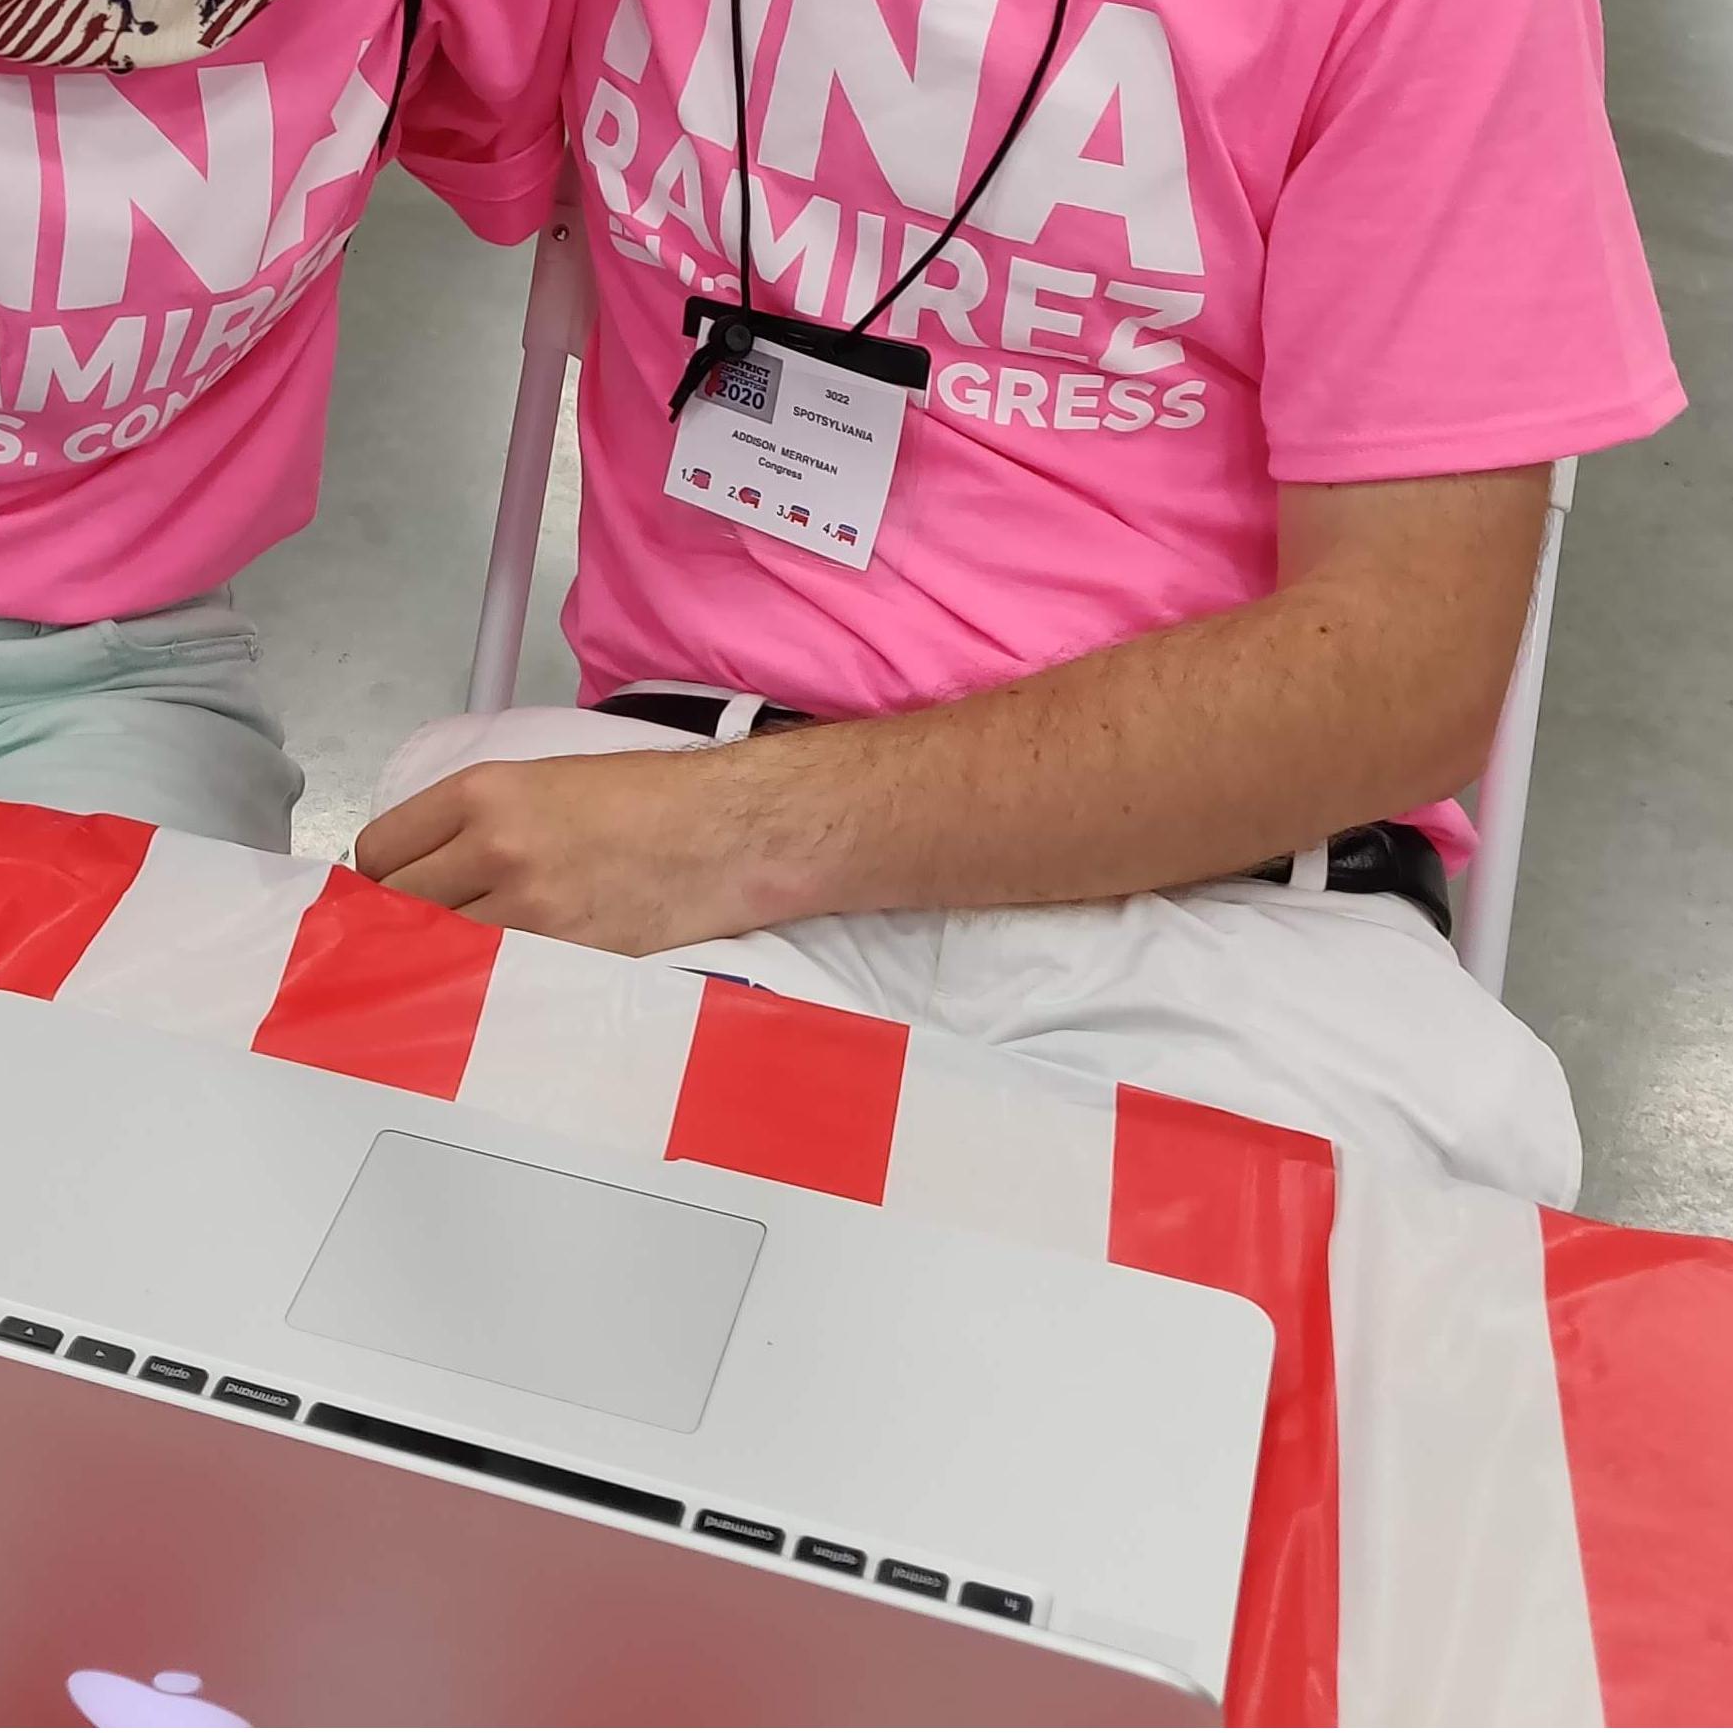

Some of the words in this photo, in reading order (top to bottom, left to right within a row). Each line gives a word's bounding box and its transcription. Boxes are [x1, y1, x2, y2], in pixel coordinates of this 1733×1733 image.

[582, 76, 1206, 375] RAMIREZ
[715, 379, 765, 410] 2020
[824, 389, 850, 406] 3022
[936, 362, 1207, 432] GRESS
[793, 406, 874, 442] SPOTSYLVANIA
[731, 429, 776, 453] ADDISON
[780, 446, 838, 476] MERRYMAN
[757, 456, 803, 481] Congress
[151, 1360, 191, 1382] option
[224, 1382, 290, 1407] command
[703, 1515, 775, 1542] command
[812, 1544, 859, 1566] option
[891, 1566, 942, 1588] control
